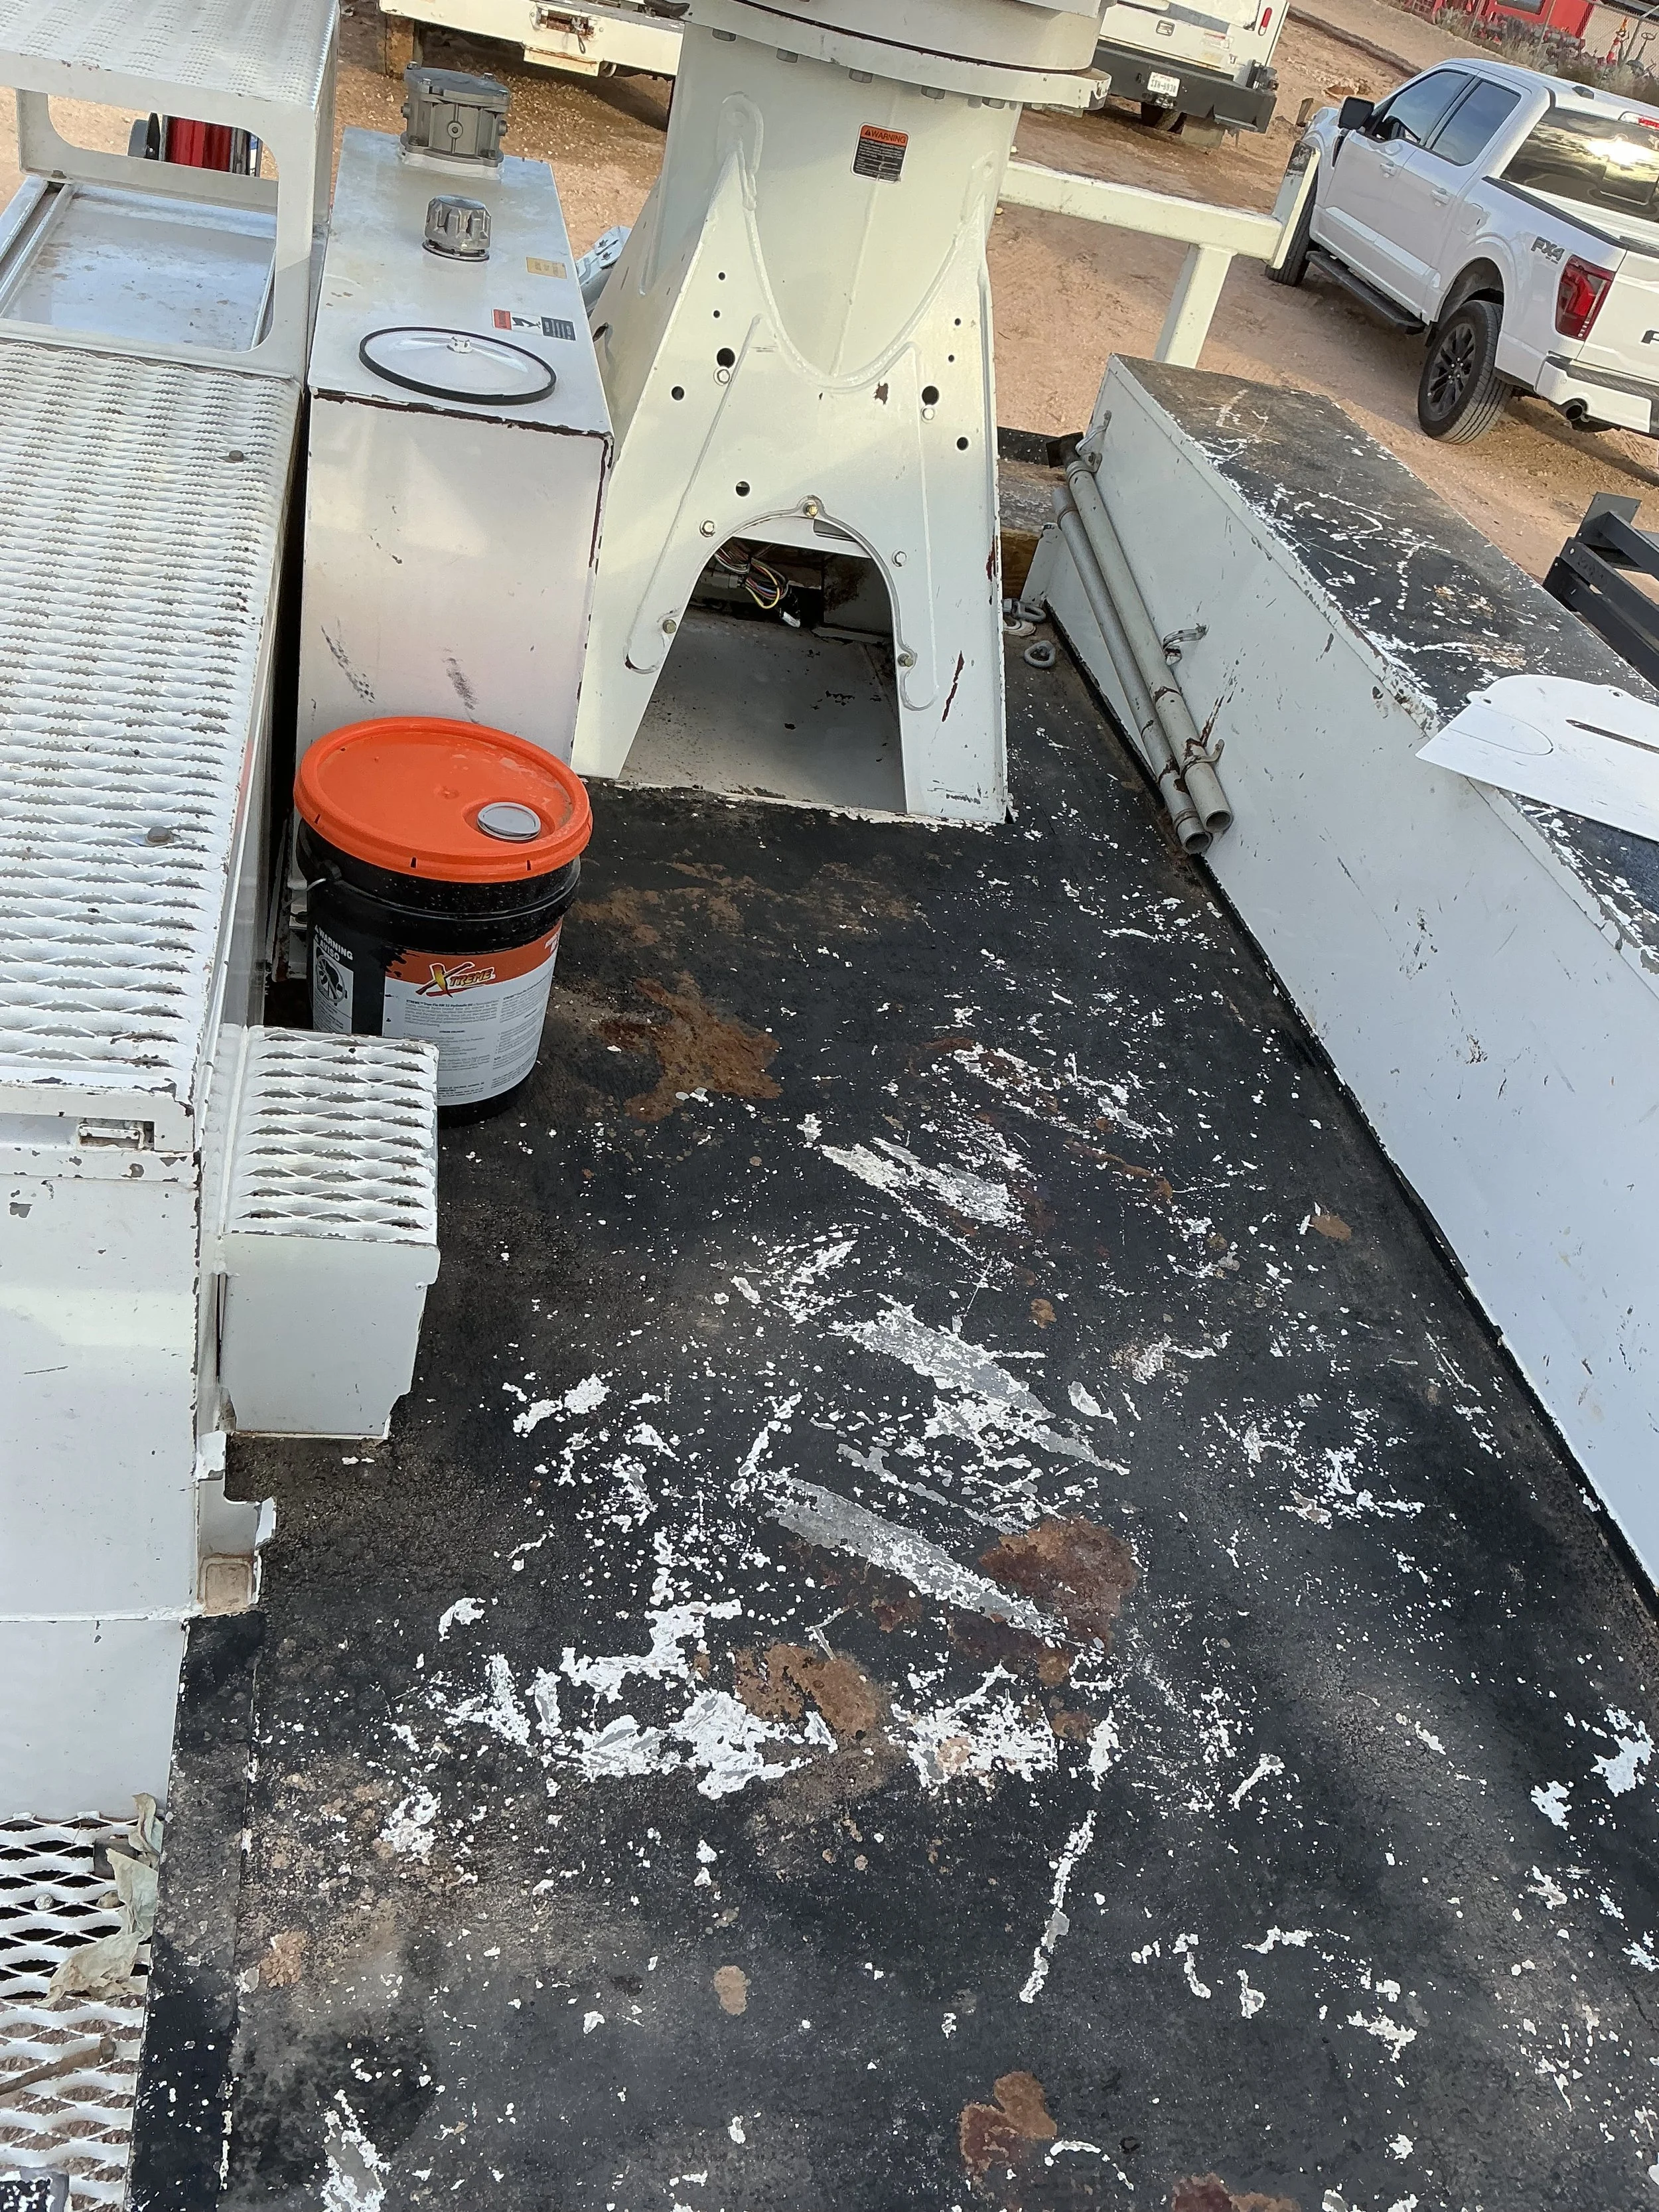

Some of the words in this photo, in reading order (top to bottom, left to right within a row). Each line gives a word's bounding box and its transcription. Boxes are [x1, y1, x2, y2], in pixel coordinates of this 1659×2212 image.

[871, 129, 906, 143] WARNING
[1531, 236, 1565, 263] FX4
[319, 927, 354, 961] WARNING
[320, 940, 340, 962] AVISO
[415, 962, 496, 998] XTREME
